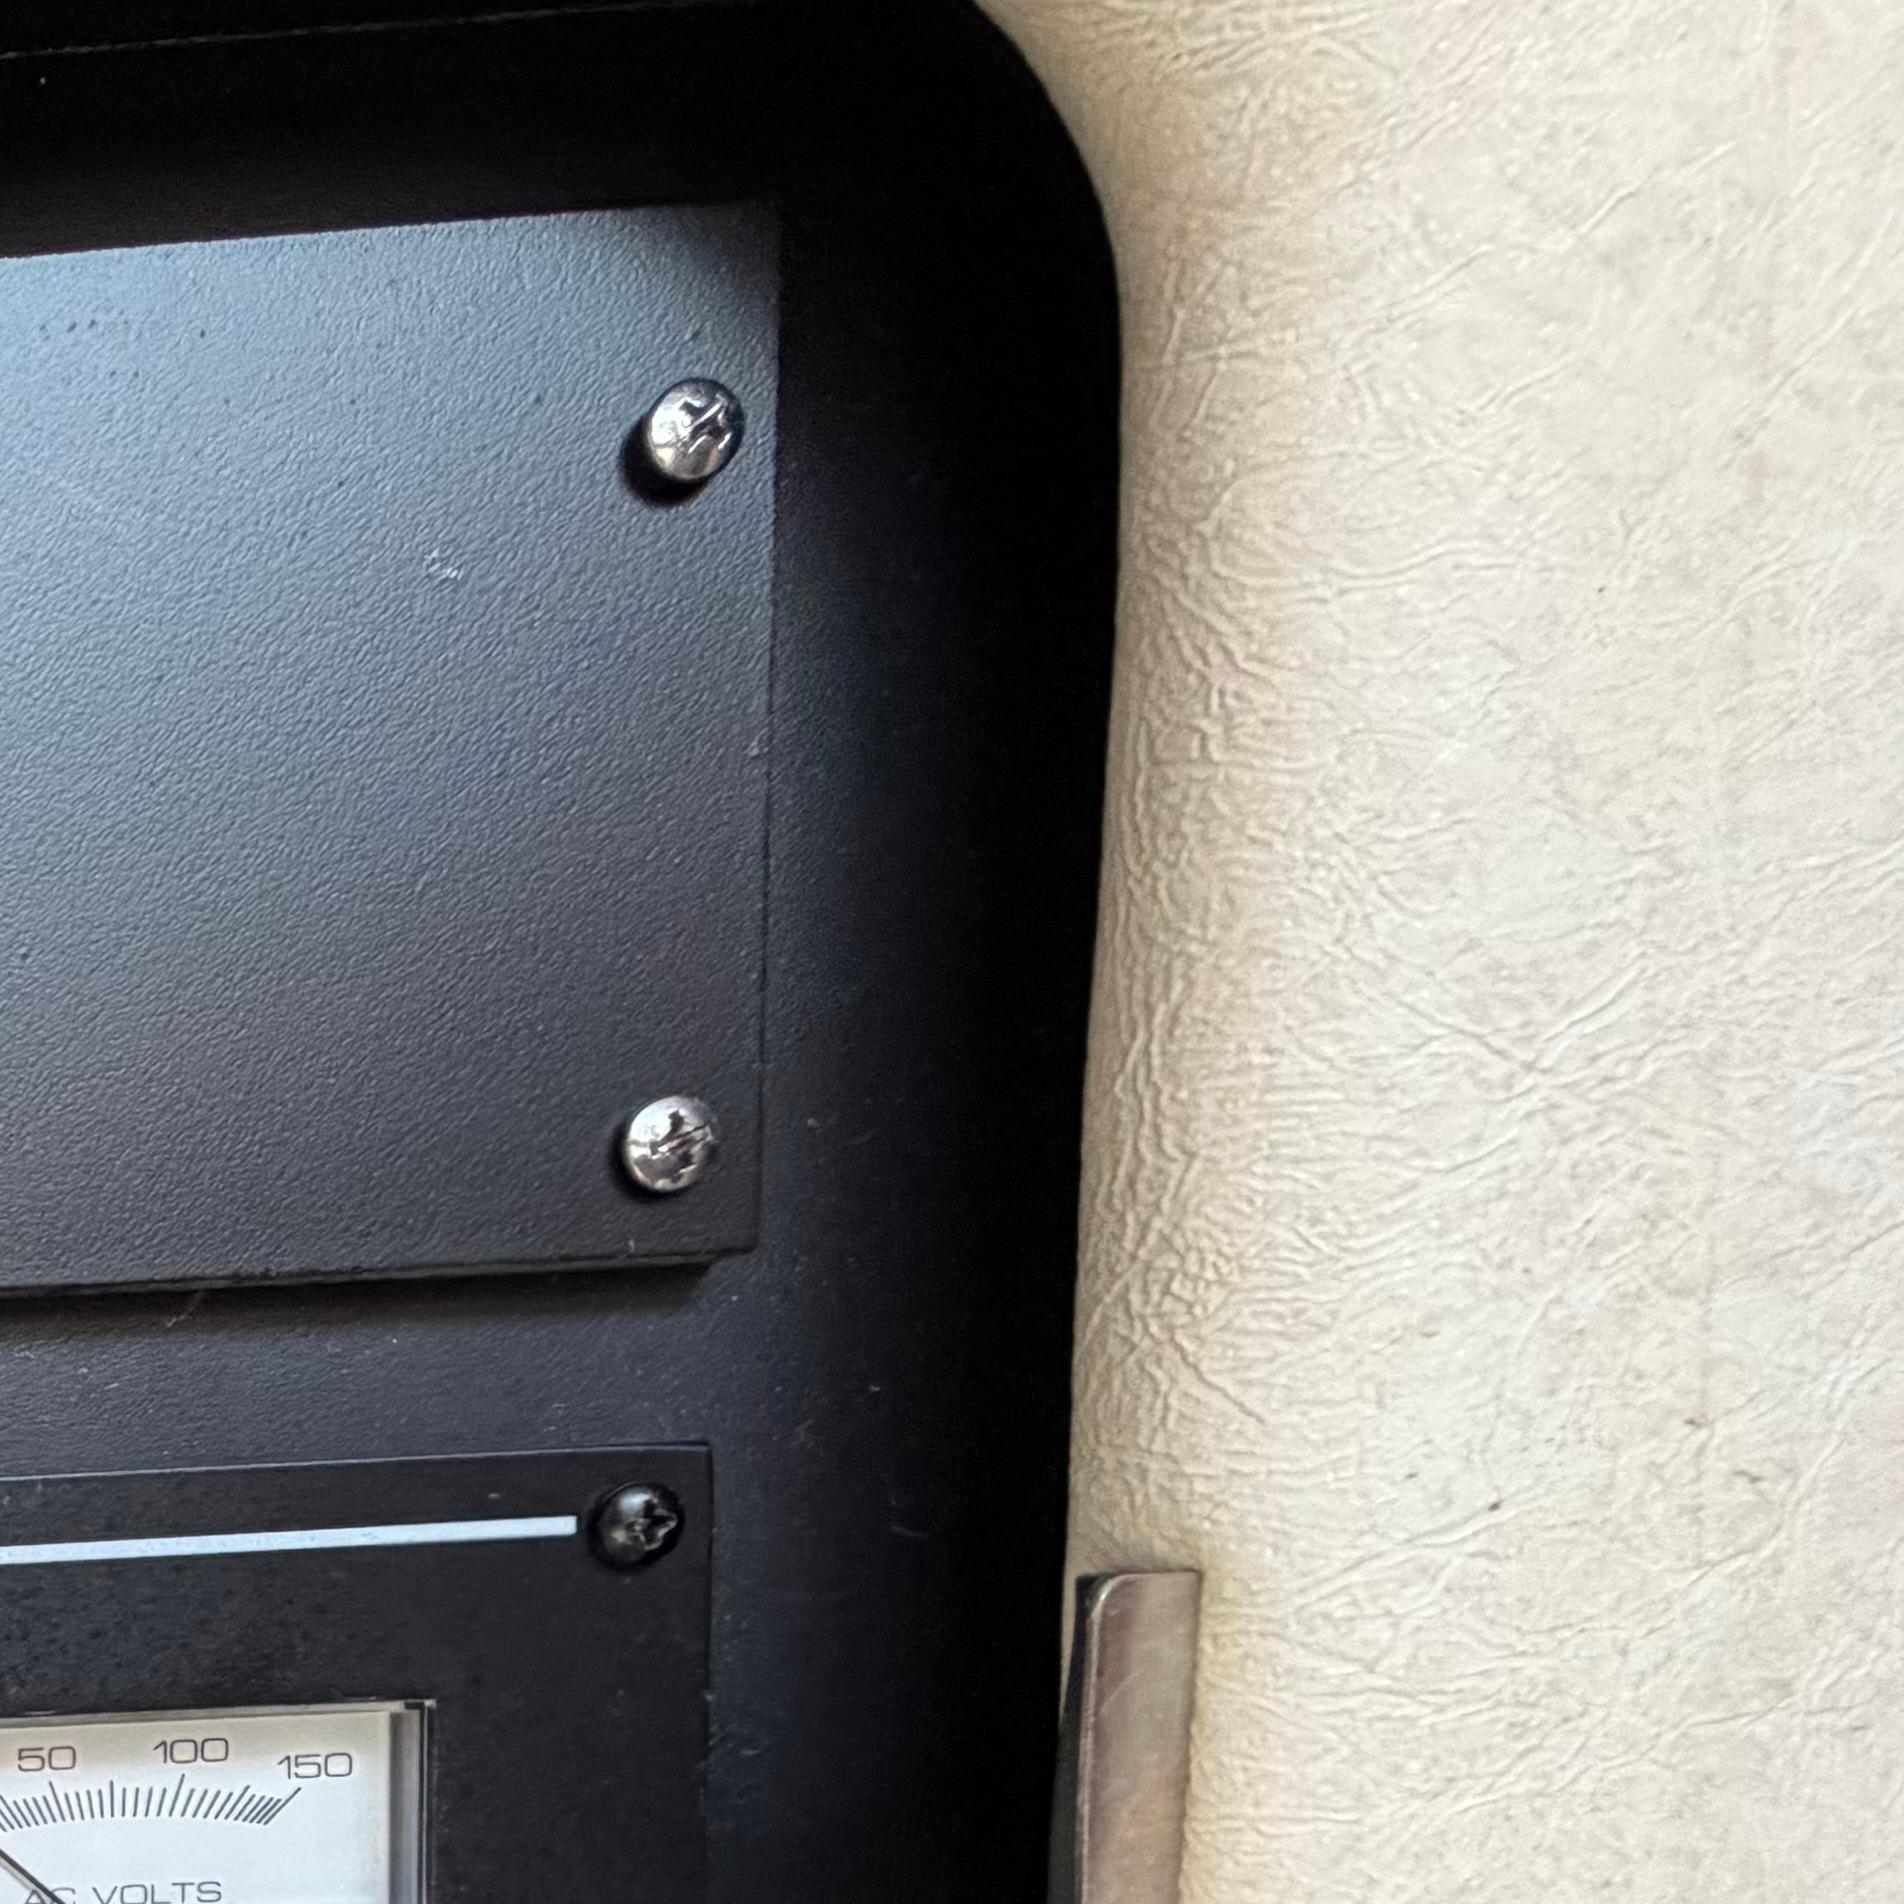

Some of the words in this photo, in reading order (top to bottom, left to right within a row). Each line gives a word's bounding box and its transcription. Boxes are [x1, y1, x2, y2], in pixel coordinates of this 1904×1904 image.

[17, 1745, 78, 1772] 50
[153, 1737, 230, 1765] 100
[277, 1752, 354, 1780] 150
